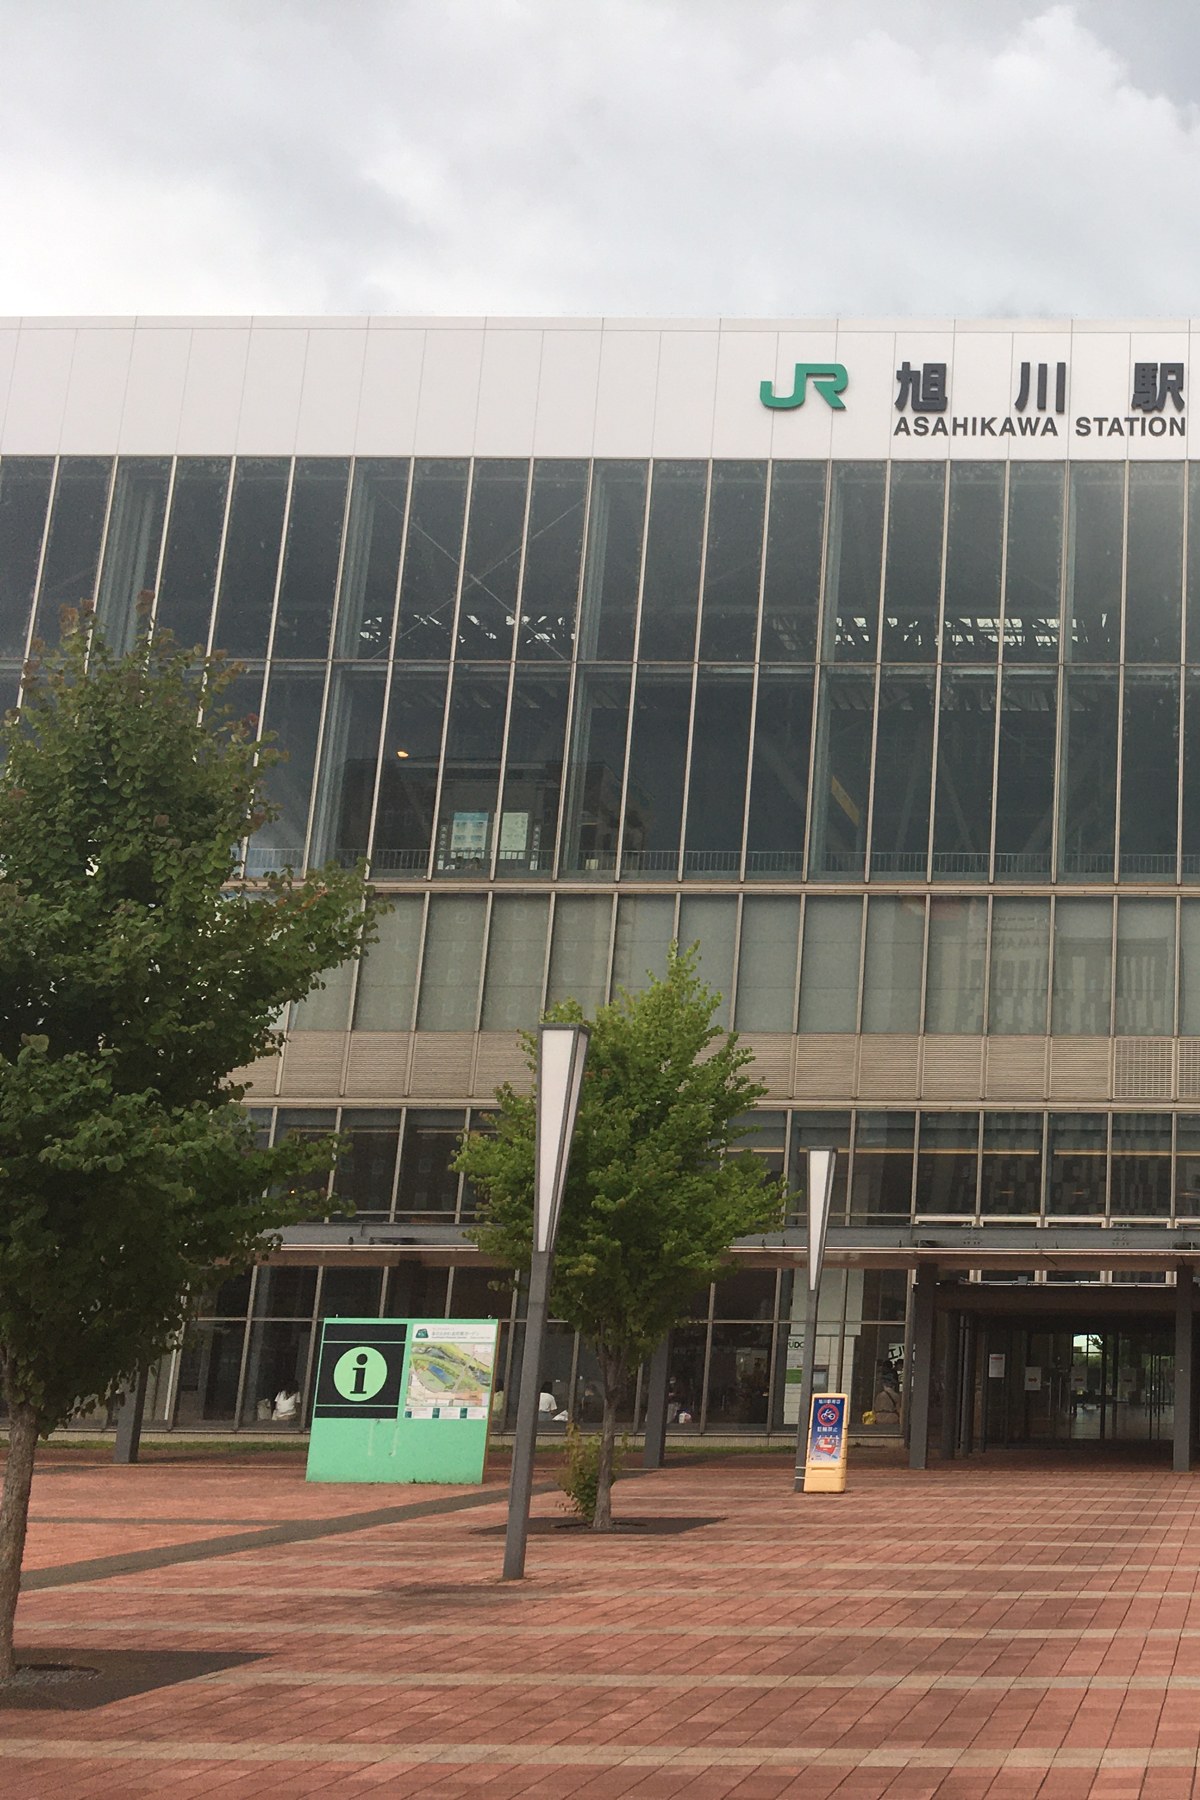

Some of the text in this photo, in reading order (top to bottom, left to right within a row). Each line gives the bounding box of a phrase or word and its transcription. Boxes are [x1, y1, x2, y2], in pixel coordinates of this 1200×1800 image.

[760, 362, 849, 411] JR
[894, 362, 1185, 414] 旭川駅
[893, 416, 1186, 437] ASAHIKAWA STATION
